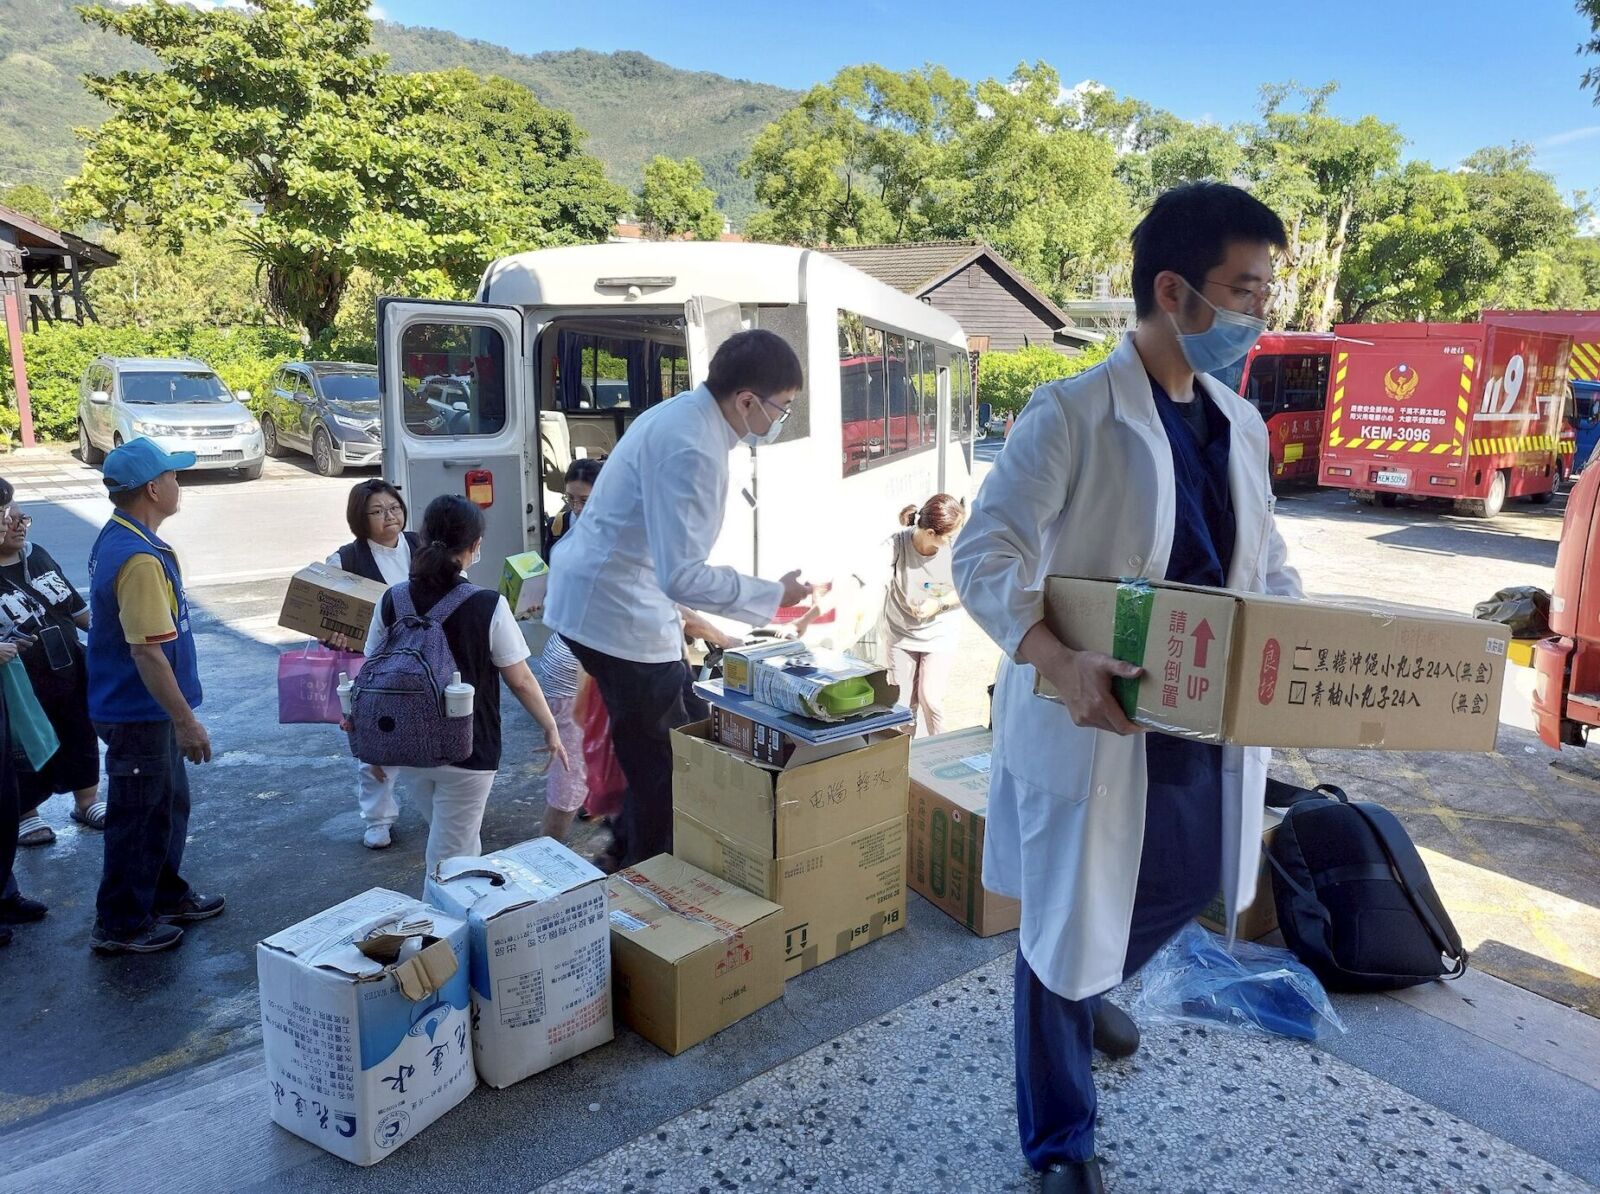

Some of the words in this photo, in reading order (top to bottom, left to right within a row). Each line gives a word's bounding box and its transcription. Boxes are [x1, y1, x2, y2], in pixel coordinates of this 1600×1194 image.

[1481, 354, 1524, 413] 119
[1360, 426, 1431, 441] KEM-3096
[1161, 610, 1188, 709] 請勿倒置
[1187, 675, 1210, 701] UP
